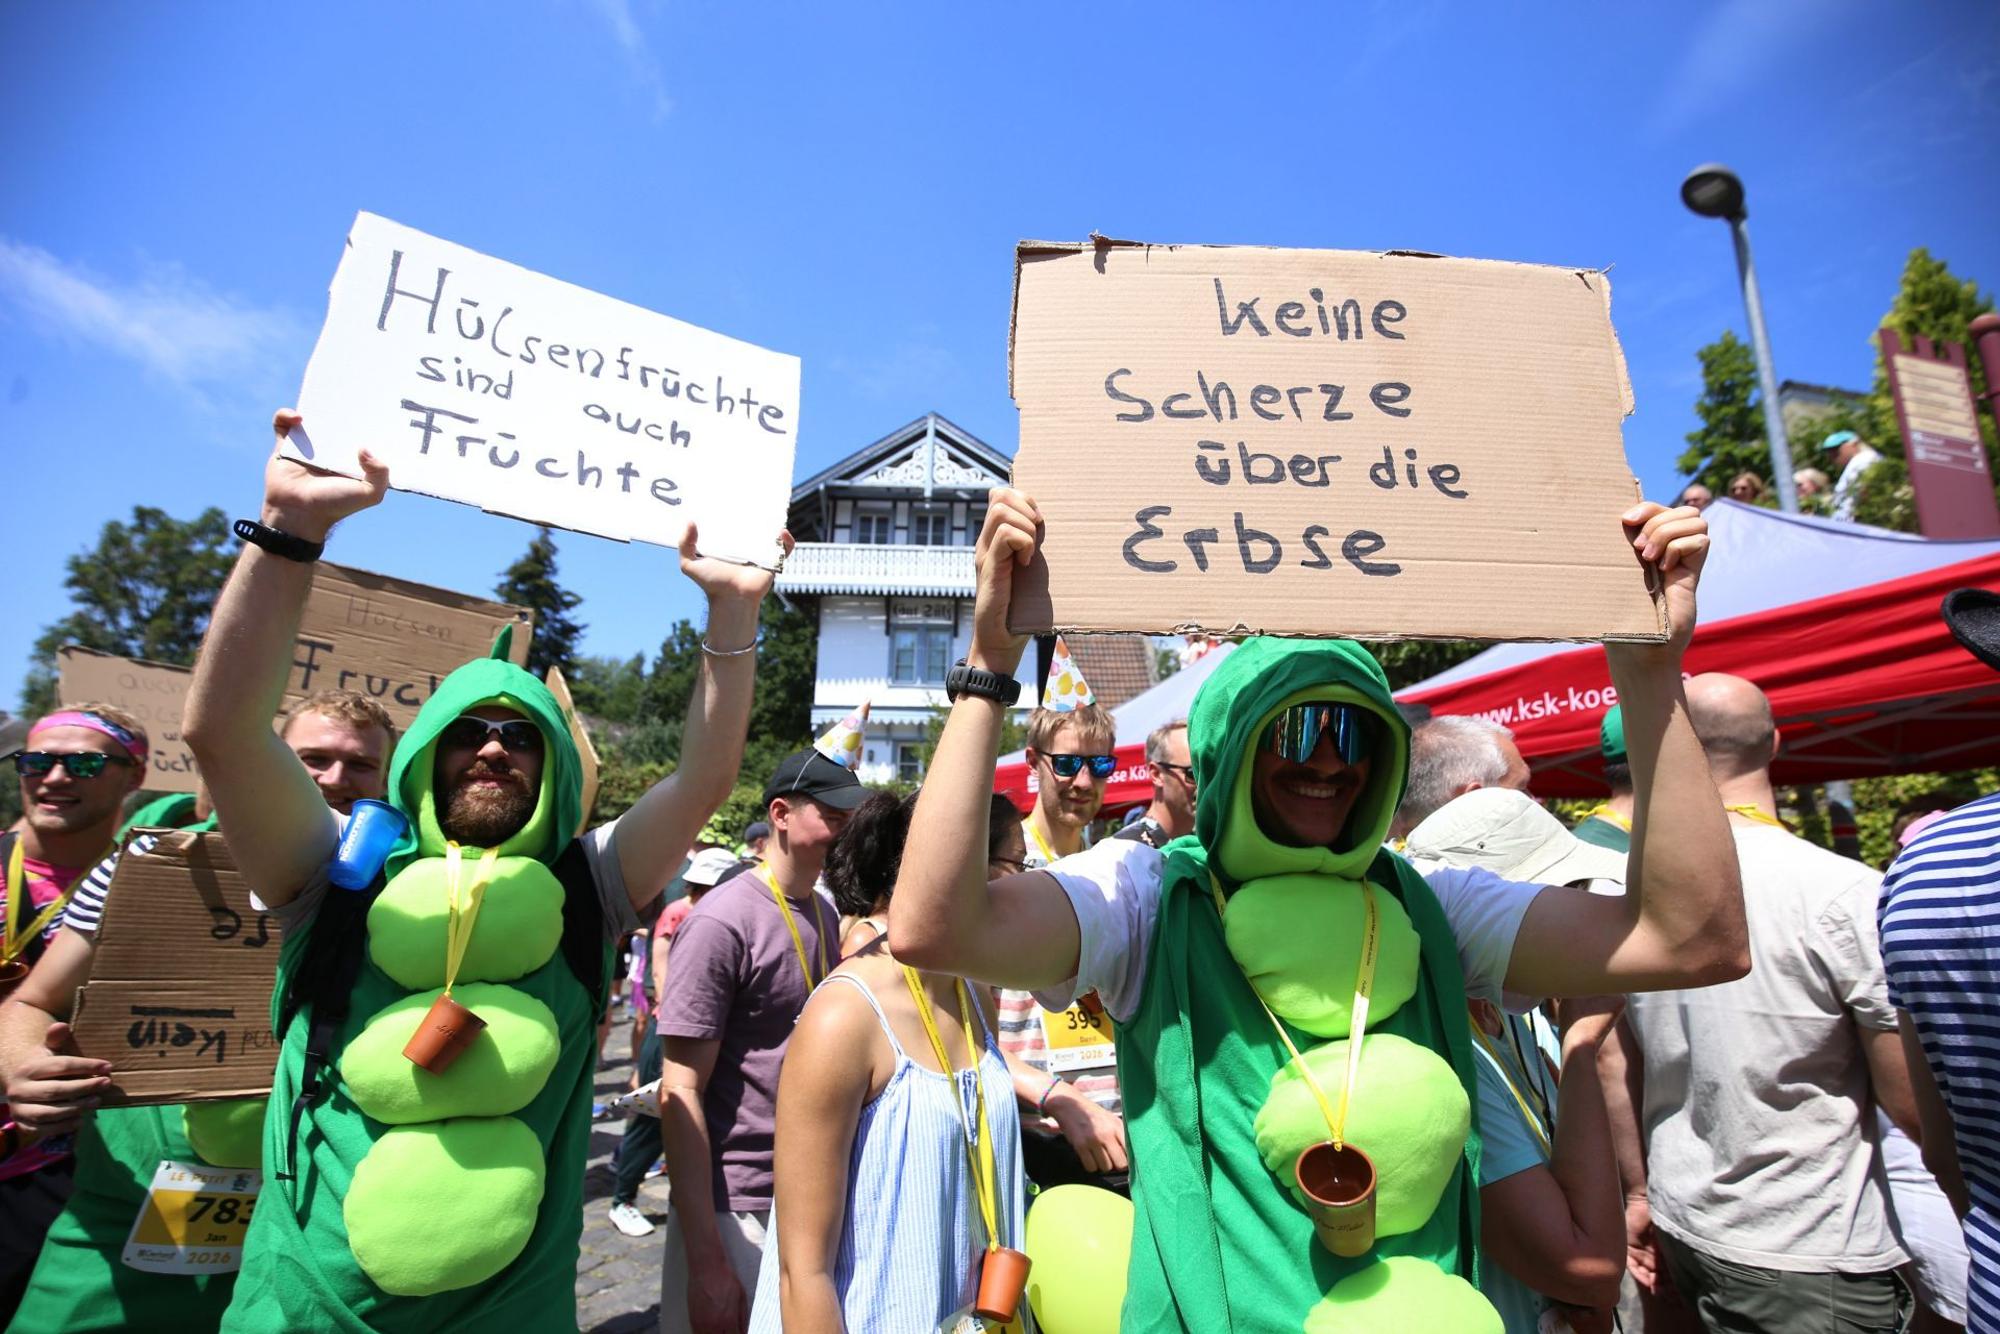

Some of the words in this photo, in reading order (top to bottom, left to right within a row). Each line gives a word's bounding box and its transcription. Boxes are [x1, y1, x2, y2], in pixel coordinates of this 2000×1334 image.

[1214, 277, 1408, 342] keine
[376, 249, 788, 434] Hülsenfrüchte
[416, 355, 514, 400] sind
[582, 403, 692, 449] auch
[1104, 367, 1413, 423] Scherze
[400, 398, 683, 506] Früchte
[1194, 440, 1342, 487] über
[1368, 444, 1471, 500] die
[1122, 505, 1405, 577] Erbse
[1066, 1010, 1102, 1030] 395
[185, 1251, 232, 1265] 2026
[204, 1232, 229, 1243] Jan
